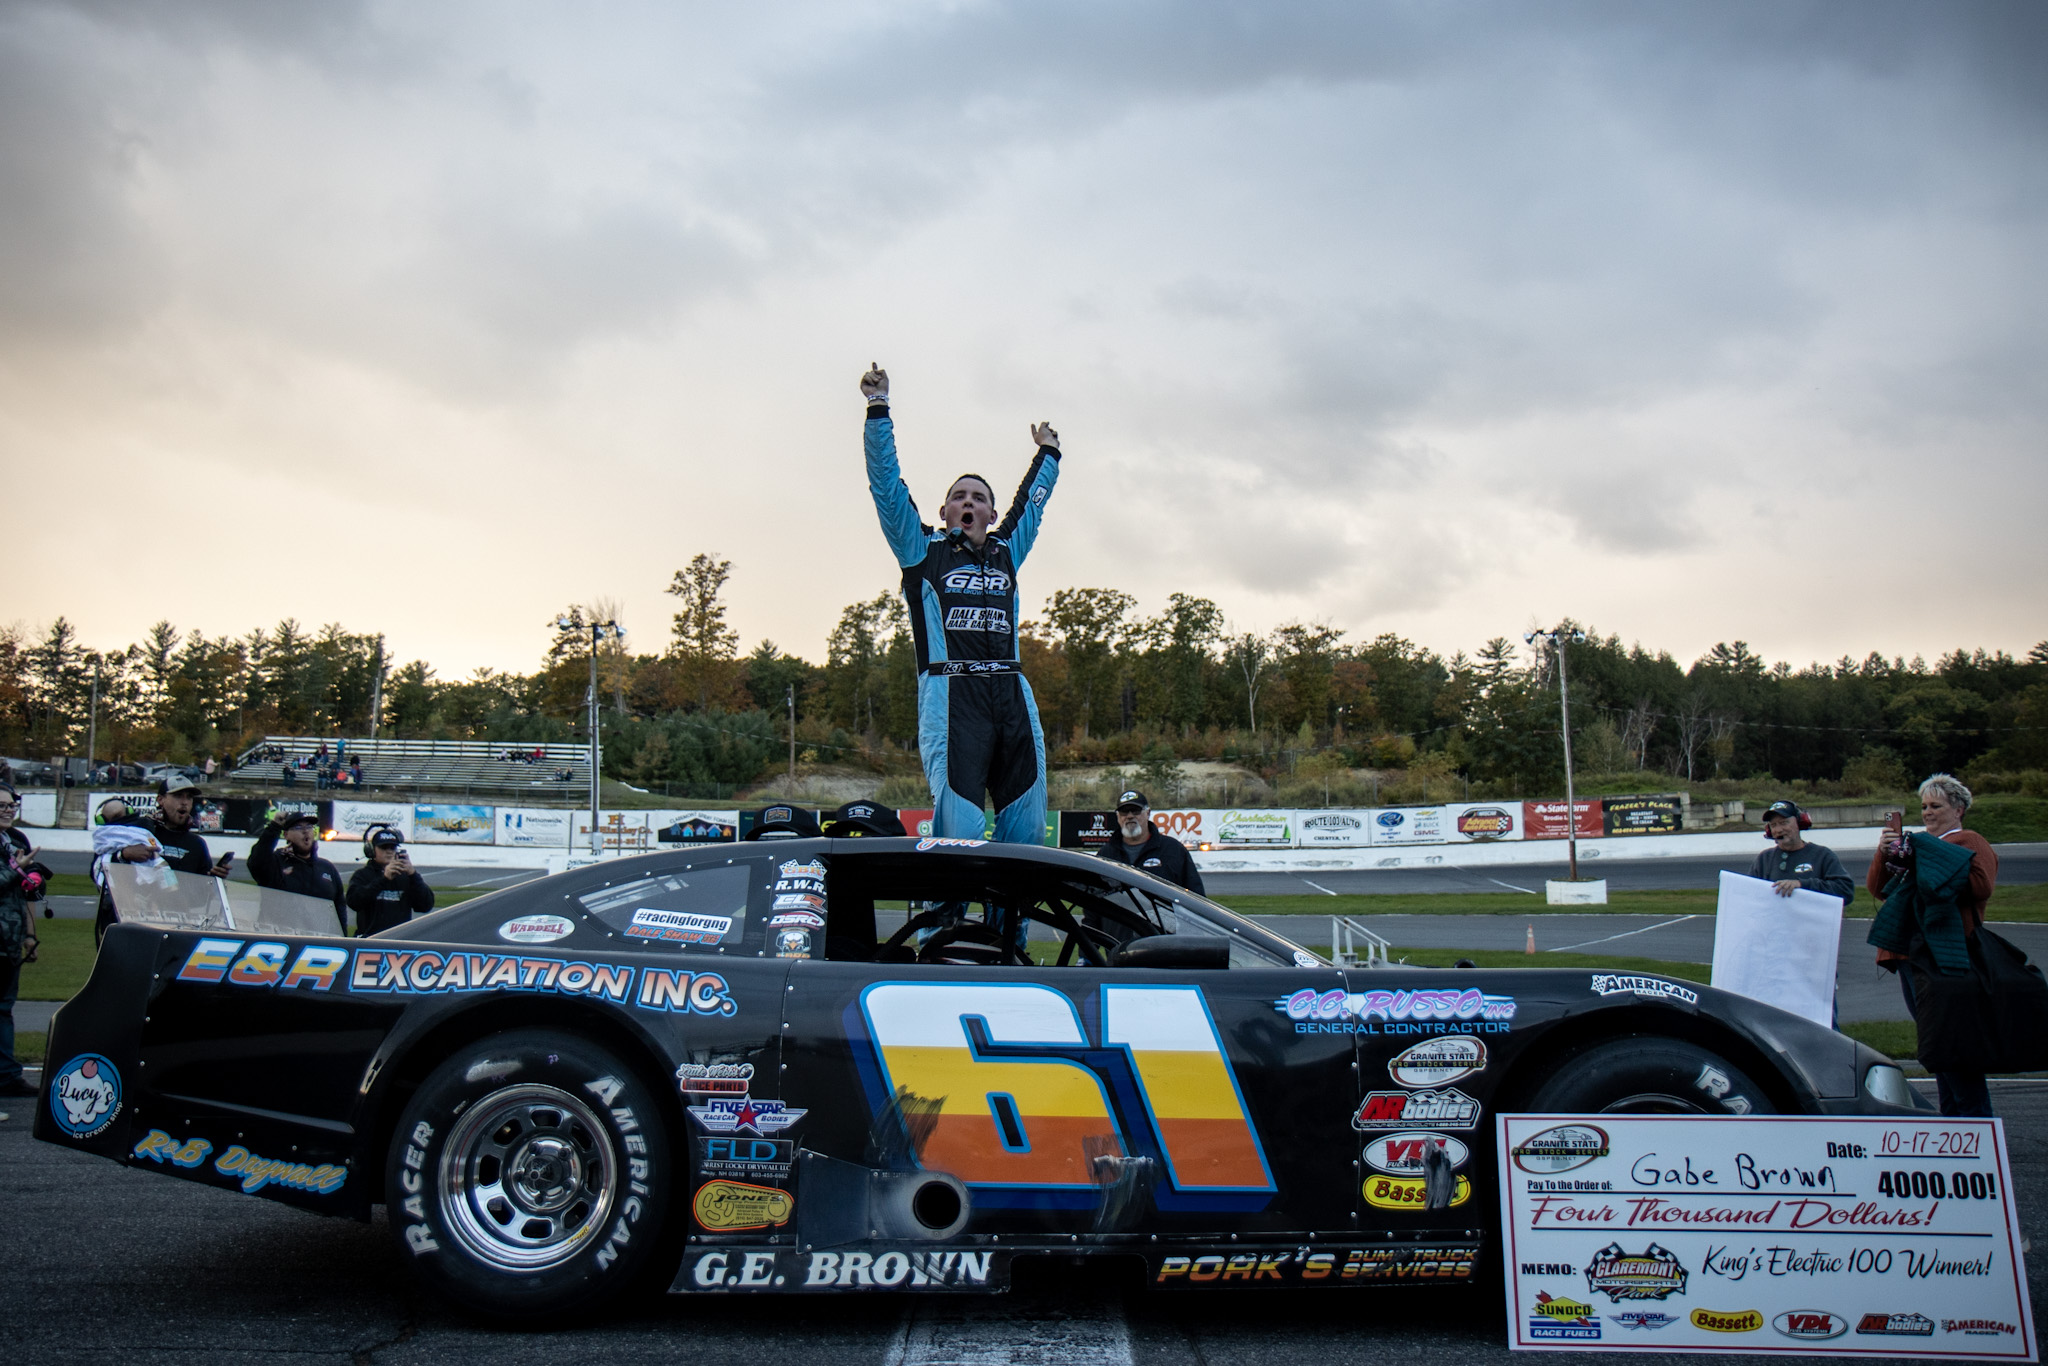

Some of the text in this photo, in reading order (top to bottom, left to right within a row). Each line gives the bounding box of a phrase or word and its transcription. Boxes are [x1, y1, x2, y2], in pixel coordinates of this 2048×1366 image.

[946, 574, 1006, 590] GBR
[951, 608, 1006, 621] DALE SHAW
[947, 619, 968, 628] RACE
[277, 801, 319, 813] Travis Dube
[1547, 804, 1568, 813] State
[1609, 801, 1674, 812] FRAZER'S PLACE
[415, 817, 493, 830] HIRING NOW
[525, 816, 563, 825] Nationwide
[1153, 811, 1202, 837] 802
[1304, 815, 1361, 829] ROUTE 103 AUTO
[1465, 818, 1499, 826] Advance
[1077, 829, 1115, 838] BLACK ROC
[1413, 829, 1441, 837] GMC
[775, 879, 827, 896] R.W.R.
[509, 921, 565, 935] WADDELL
[637, 909, 729, 932] #racingforgng
[625, 924, 660, 939] DALE
[661, 926, 702, 943] SHAW
[176, 937, 739, 1018] E&R EXCAVATION INC.
[1602, 975, 1697, 1003] AMERICAN
[1636, 989, 1666, 997] RACER
[1360, 987, 1484, 1021] RUSSO
[1484, 1001, 1517, 1019] INC
[1294, 1022, 1511, 1035] GENERAL CONTRACTOR
[1410, 1052, 1475, 1061] GRANITE STATE
[1452, 1060, 1484, 1068] SERIES
[680, 1063, 708, 1079] Little
[685, 1080, 744, 1091] RACE PARTS
[858, 980, 1280, 1193] 61
[59, 1074, 116, 1116] Lucy's
[711, 1101, 785, 1114] FIVE STAR
[1360, 1095, 1475, 1121] AR bodies
[73, 1101, 124, 1140] ice cream shop
[707, 1139, 778, 1161] FLD
[1532, 1139, 1599, 1148] GRANITE STATE
[1826, 1130, 1981, 1159] Date: 10-17-2021
[1512, 1148, 1609, 1156] PRO STOCK SERIES
[134, 1128, 349, 1194] R&B Drywall
[747, 1163, 779, 1171] DRYWALL
[584, 1073, 652, 1273] AMERICAN
[1631, 1152, 1837, 1193] Gabe Brown
[403, 1119, 441, 1258] RACER
[1374, 1180, 1430, 1203] Bass
[1527, 1179, 1613, 1192] Pay To the Order of:
[1877, 1170, 1998, 1201] 4000.00!
[713, 1194, 781, 1204] JONES
[1530, 1195, 1940, 1229] Four Thousand Dollars!
[693, 1251, 996, 1288] G.E. BROWN
[1156, 1246, 1479, 1283] PORK'S DUM TRUCK
[1340, 1261, 1474, 1278] SERVICES
[1521, 1262, 1578, 1276] MEMO:
[1595, 1261, 1677, 1279] CLAREMONT
[1702, 1243, 1993, 1281] King's Electric 100 Winner!
[1594, 1278, 1680, 1286] MOTORSPORTS
[1607, 1285, 1664, 1303] Park
[1536, 1303, 1592, 1317] SUNOCO
[1621, 1312, 1666, 1321] FIVE STAR
[1695, 1312, 1756, 1330] Bassett
[1886, 1318, 1932, 1332] bodies
[1947, 1318, 2017, 1336] AMERICAN
[1533, 1329, 1599, 1338] RACE FUELS
